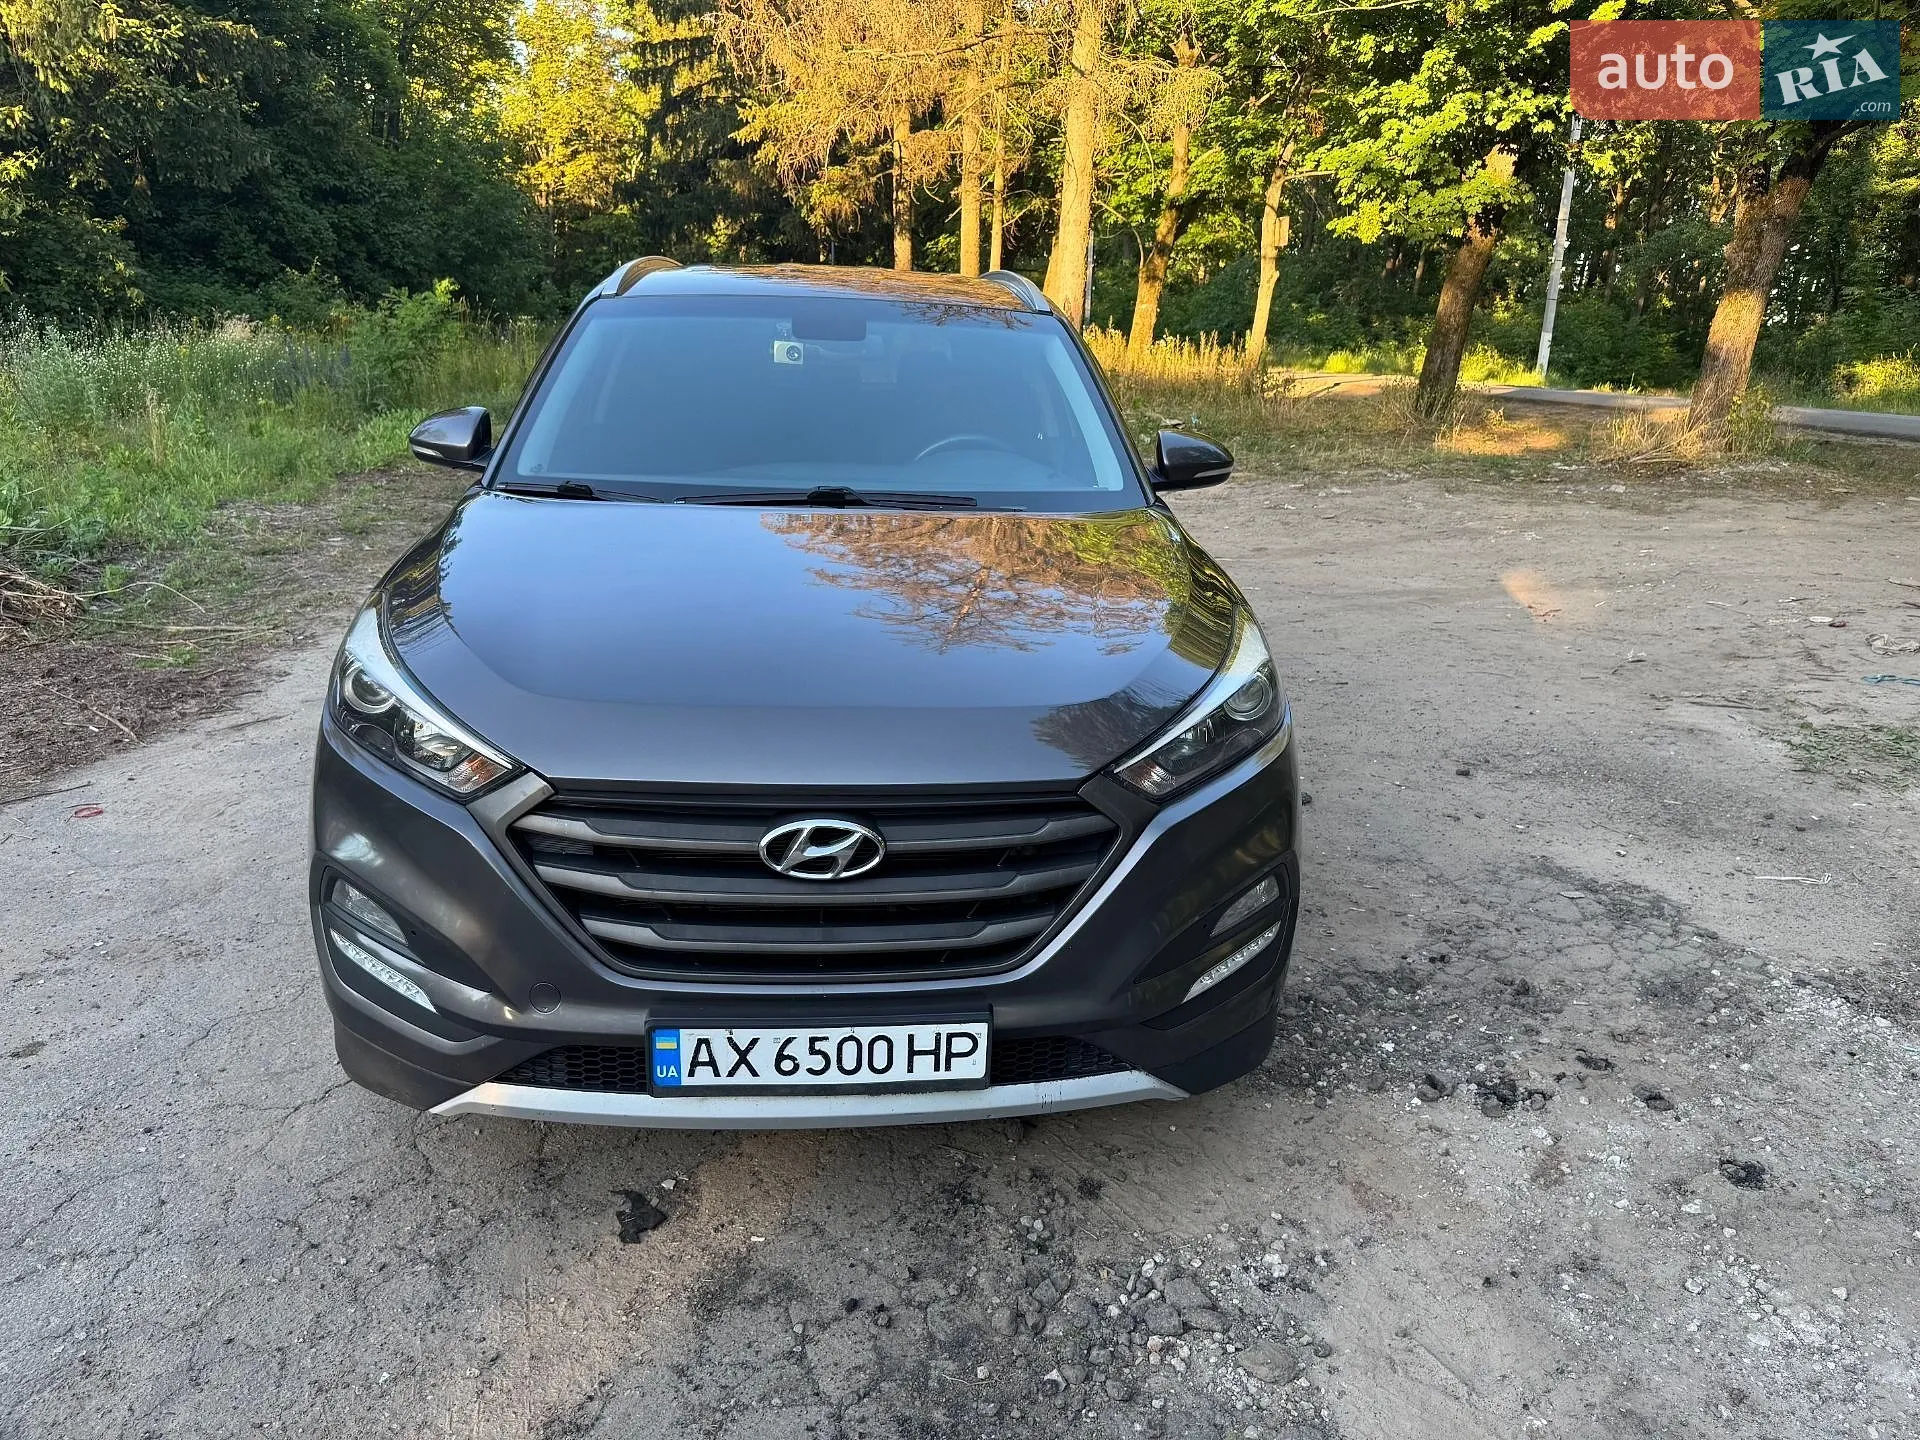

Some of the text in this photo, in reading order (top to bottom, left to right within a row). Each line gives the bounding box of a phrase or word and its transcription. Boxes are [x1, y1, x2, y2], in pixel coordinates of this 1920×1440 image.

[687, 1031, 979, 1078] AX 6500 HP
[656, 1065, 678, 1078] UA
